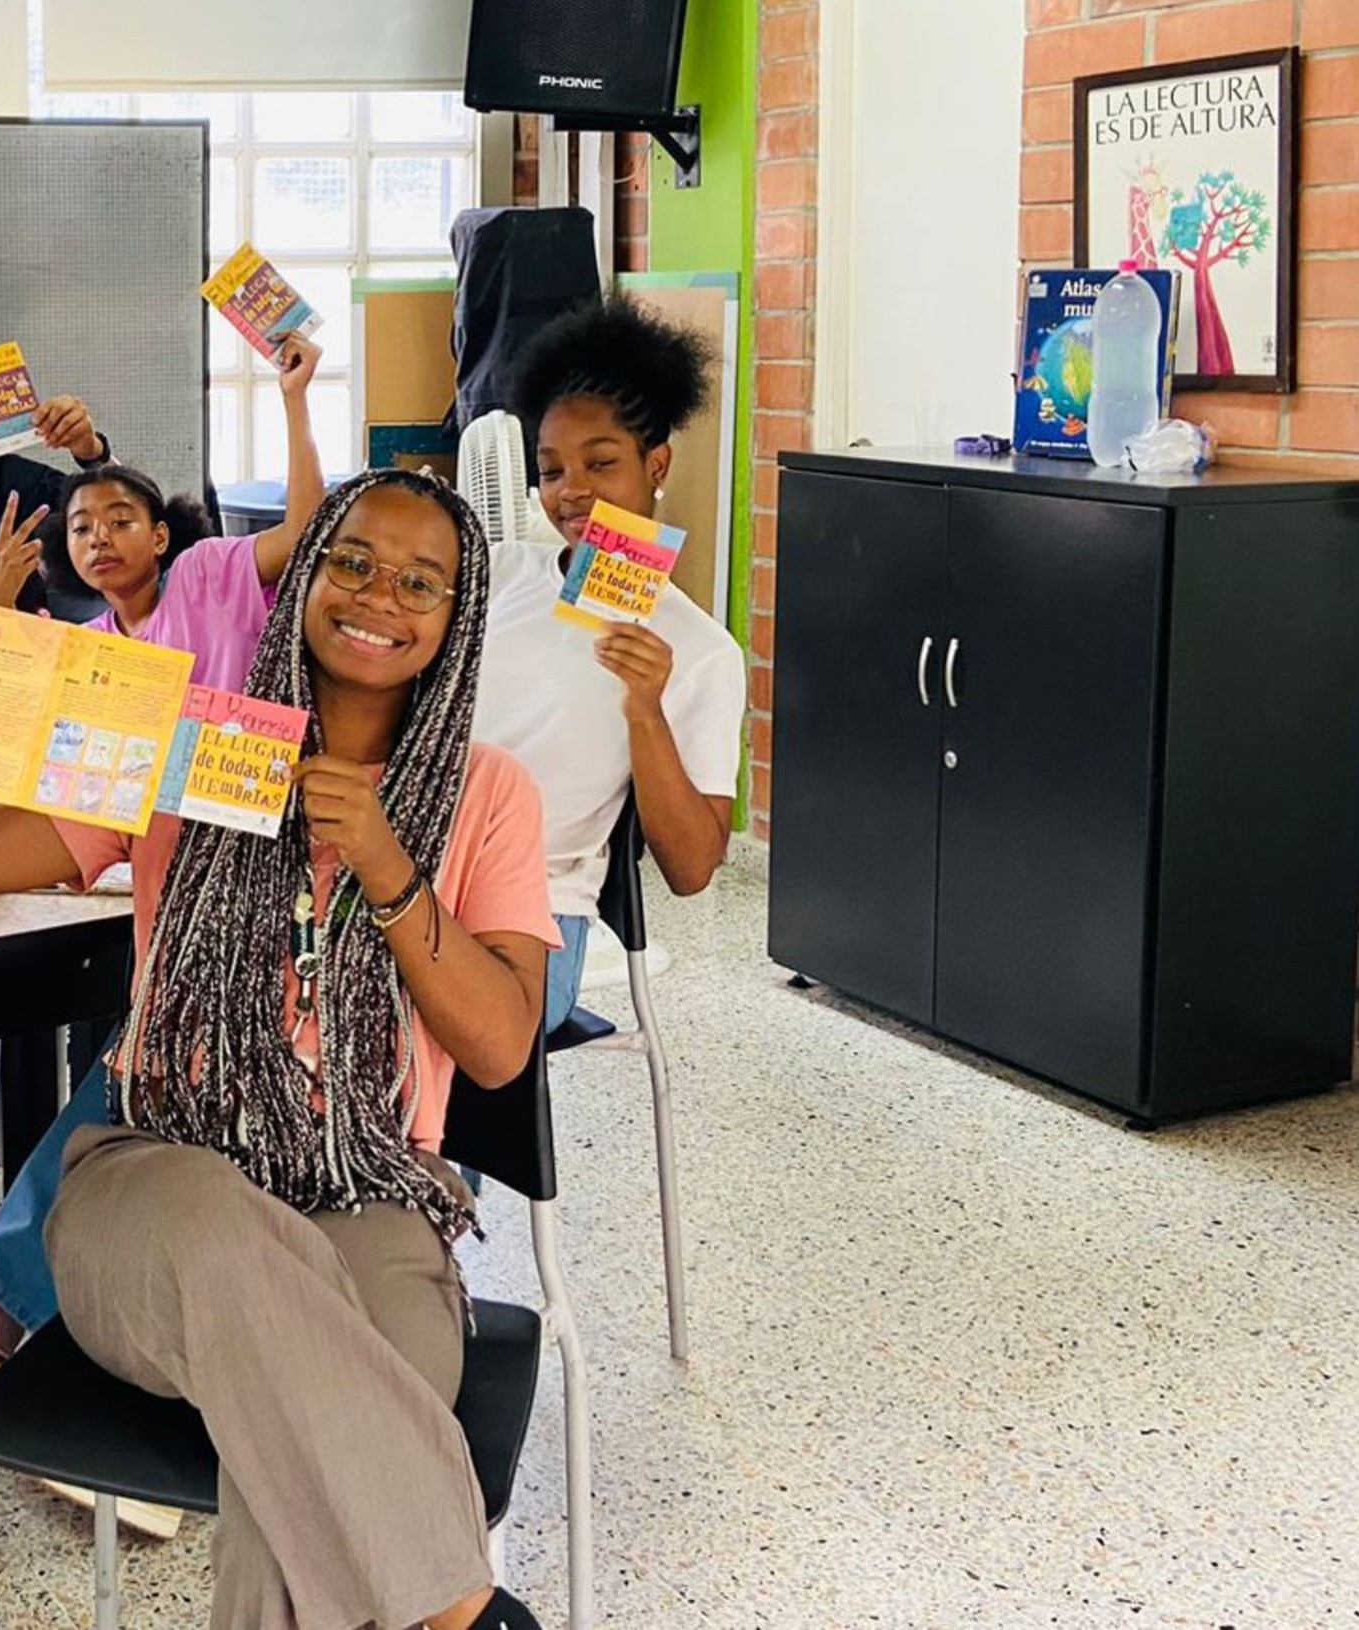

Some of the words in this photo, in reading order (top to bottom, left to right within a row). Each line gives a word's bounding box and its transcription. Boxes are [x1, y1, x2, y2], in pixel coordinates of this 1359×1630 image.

[539, 75, 604, 90] PHONIC
[1105, 90, 1135, 118] LA
[1144, 75, 1265, 113] LECTURA
[1096, 119, 1120, 145] ES
[1129, 114, 1163, 141] DE
[1170, 102, 1277, 137] ALTURA
[1060, 278, 1102, 298] Atlas
[1064, 303, 1095, 317] mu
[590, 566, 604, 581] de
[607, 573, 637, 593] todas
[640, 585, 656, 600] las
[596, 553, 614, 568] EL
[615, 559, 662, 583] LUGAR
[201, 727, 226, 750] EL
[229, 734, 291, 764] LUGAR
[195, 748, 214, 770] de
[219, 754, 261, 781] todas
[264, 765, 286, 786] las
